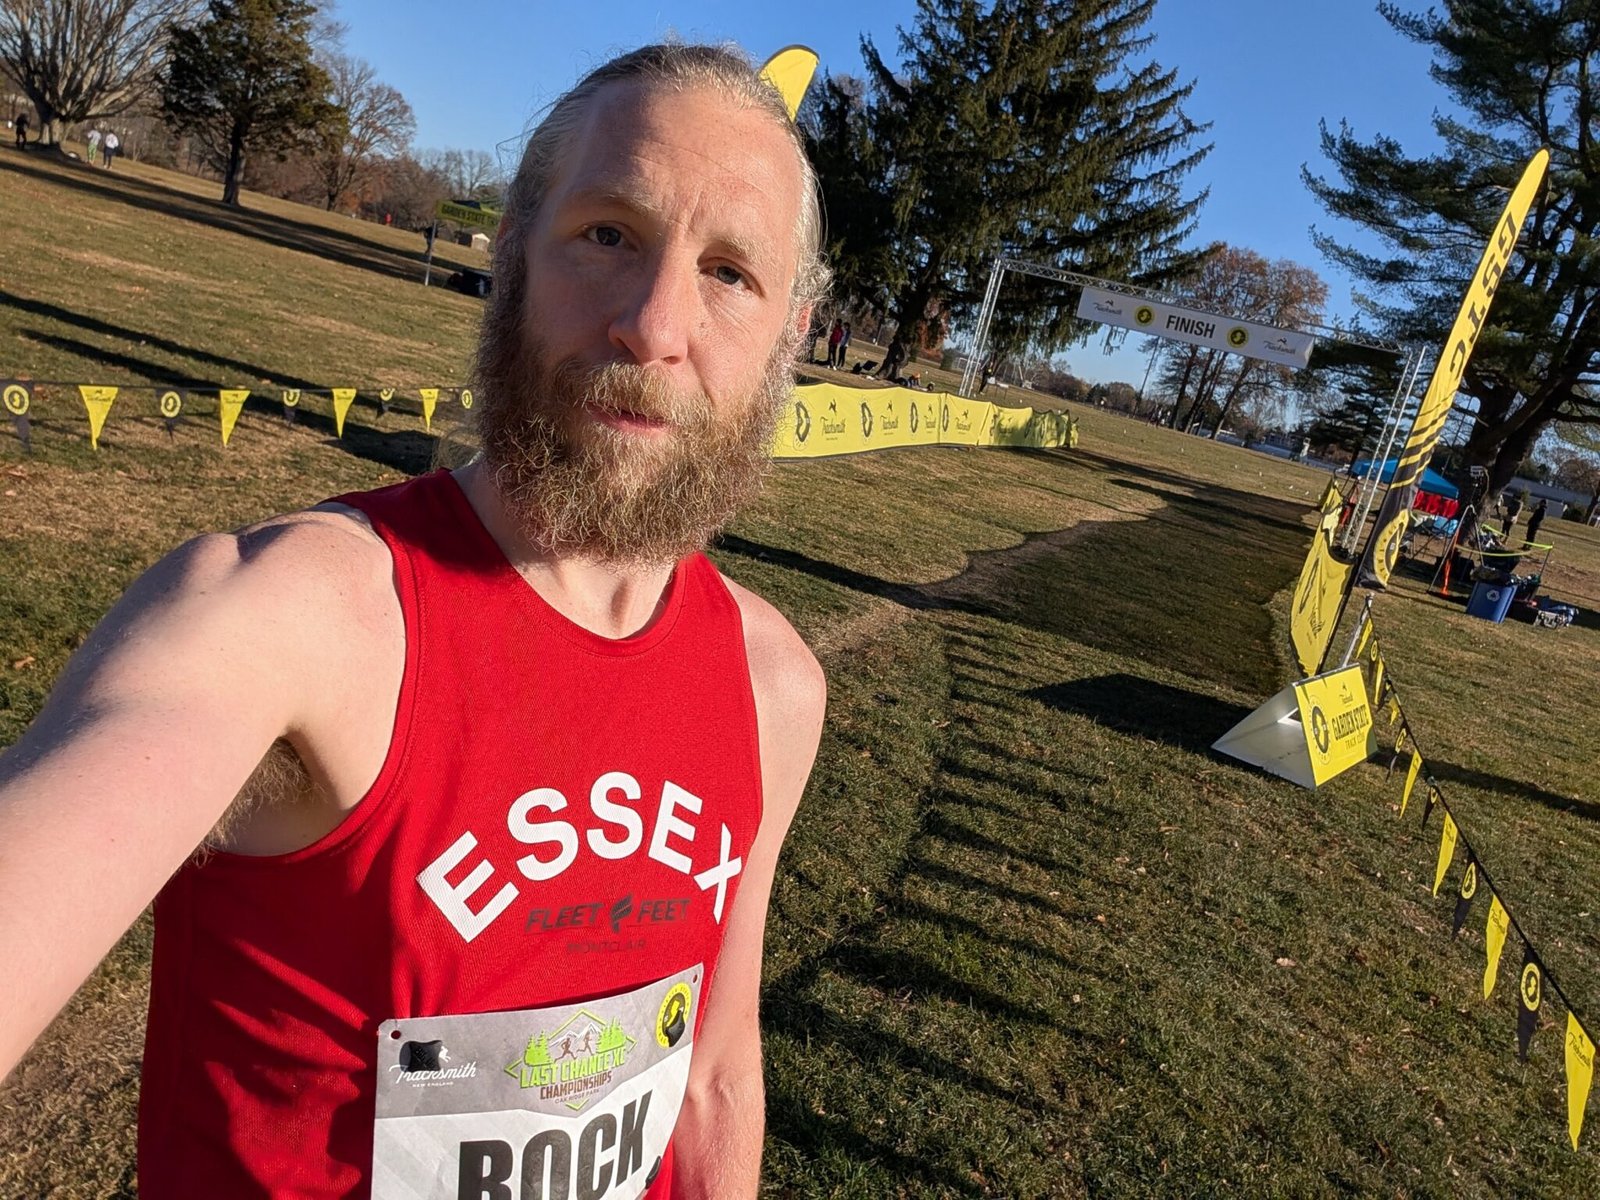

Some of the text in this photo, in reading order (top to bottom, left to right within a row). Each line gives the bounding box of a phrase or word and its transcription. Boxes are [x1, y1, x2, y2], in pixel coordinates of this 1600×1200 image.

[1450, 212, 1516, 381] GSTC
[1166, 315, 1216, 339] FINISH
[415, 771, 742, 943] ESSEX
[524, 898, 691, 934] FLEET FEET
[388, 1061, 477, 1085] Tracksmith
[520, 1063, 558, 1089] LAST
[560, 1053, 611, 1082] CHANCE
[540, 1070, 612, 1100] CHAMPIONSHIPS
[586, 1088, 600, 1097] PARK
